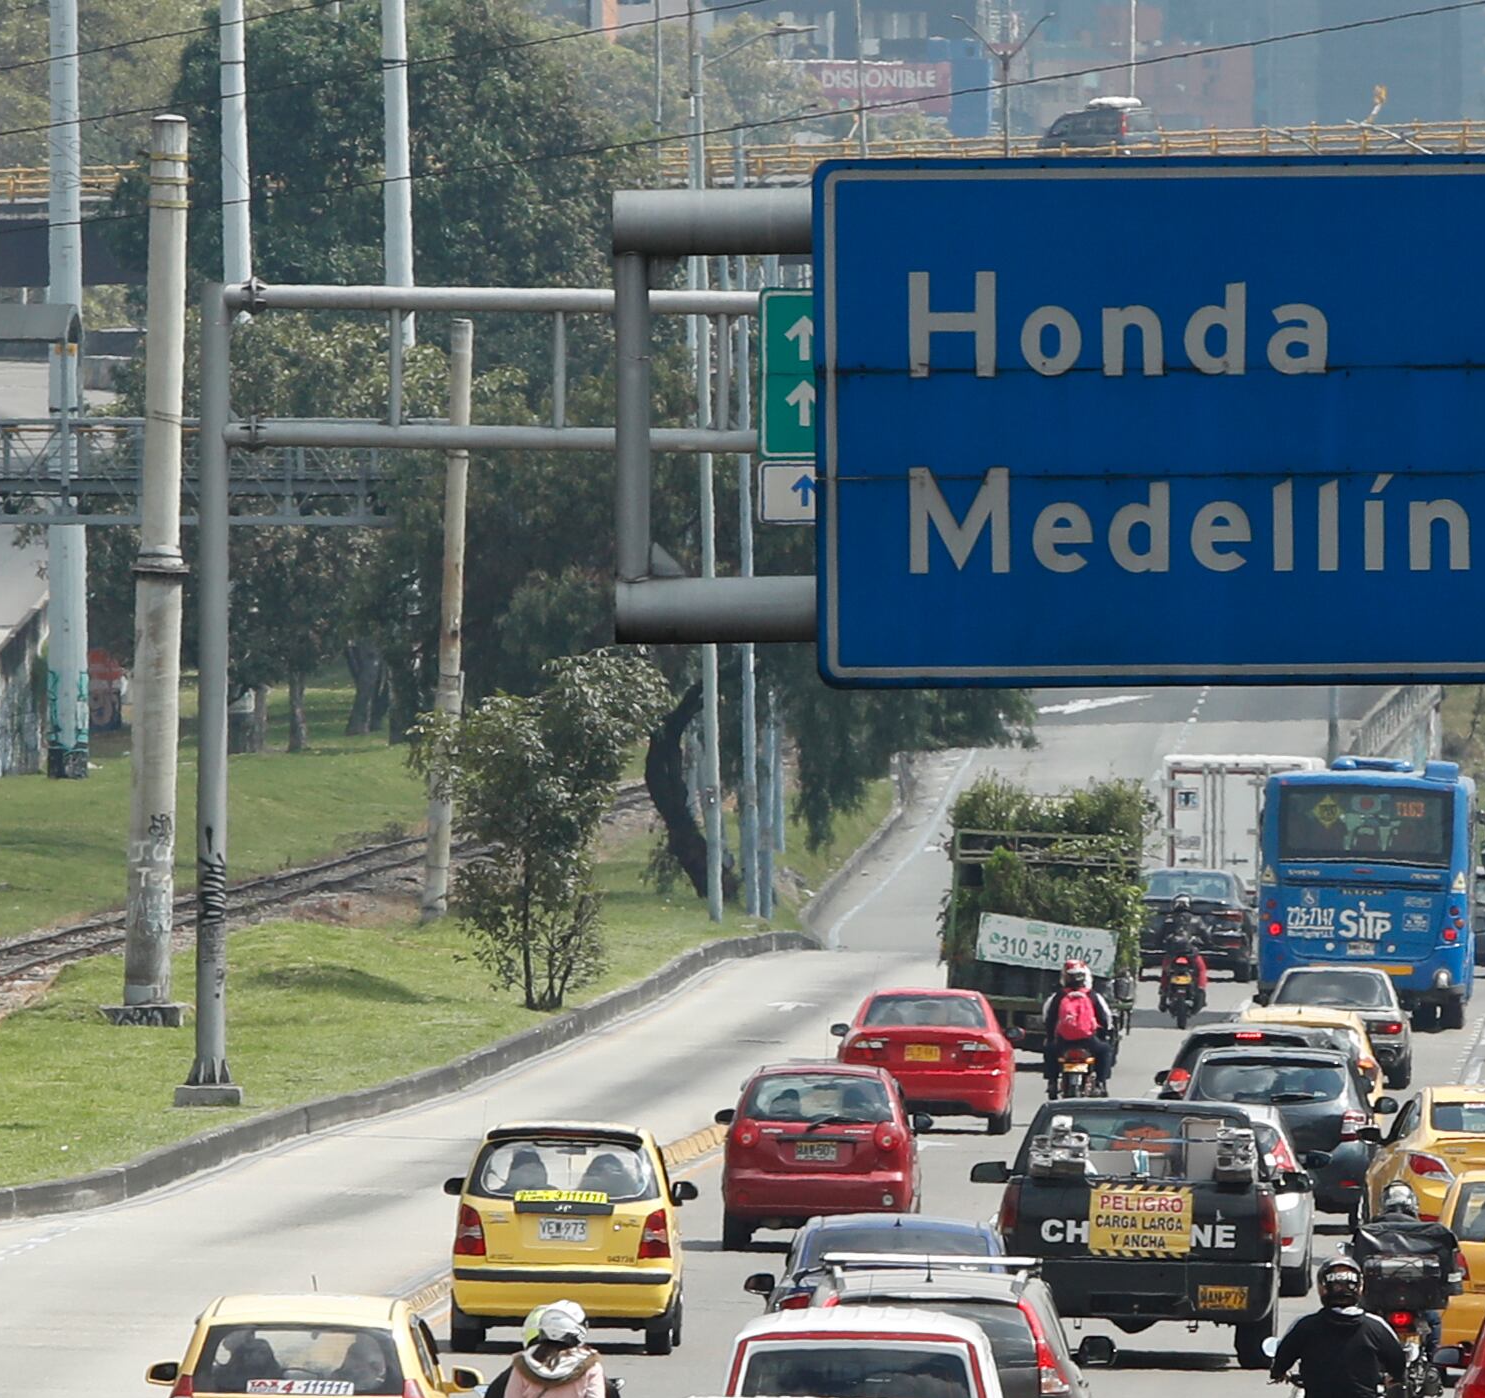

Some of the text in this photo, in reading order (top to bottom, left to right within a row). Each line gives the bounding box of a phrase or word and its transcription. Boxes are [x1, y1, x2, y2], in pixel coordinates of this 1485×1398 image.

[908, 270, 1329, 378] Honda
[909, 465, 1471, 575] Medellín
[999, 936, 1028, 957] 310
[1032, 940, 1060, 962] 343
[1100, 1194, 1183, 1214] PELIGRO
[1095, 1215, 1183, 1231] CARGA LARGA
[1111, 1234, 1166, 1249] Y ANCHA
